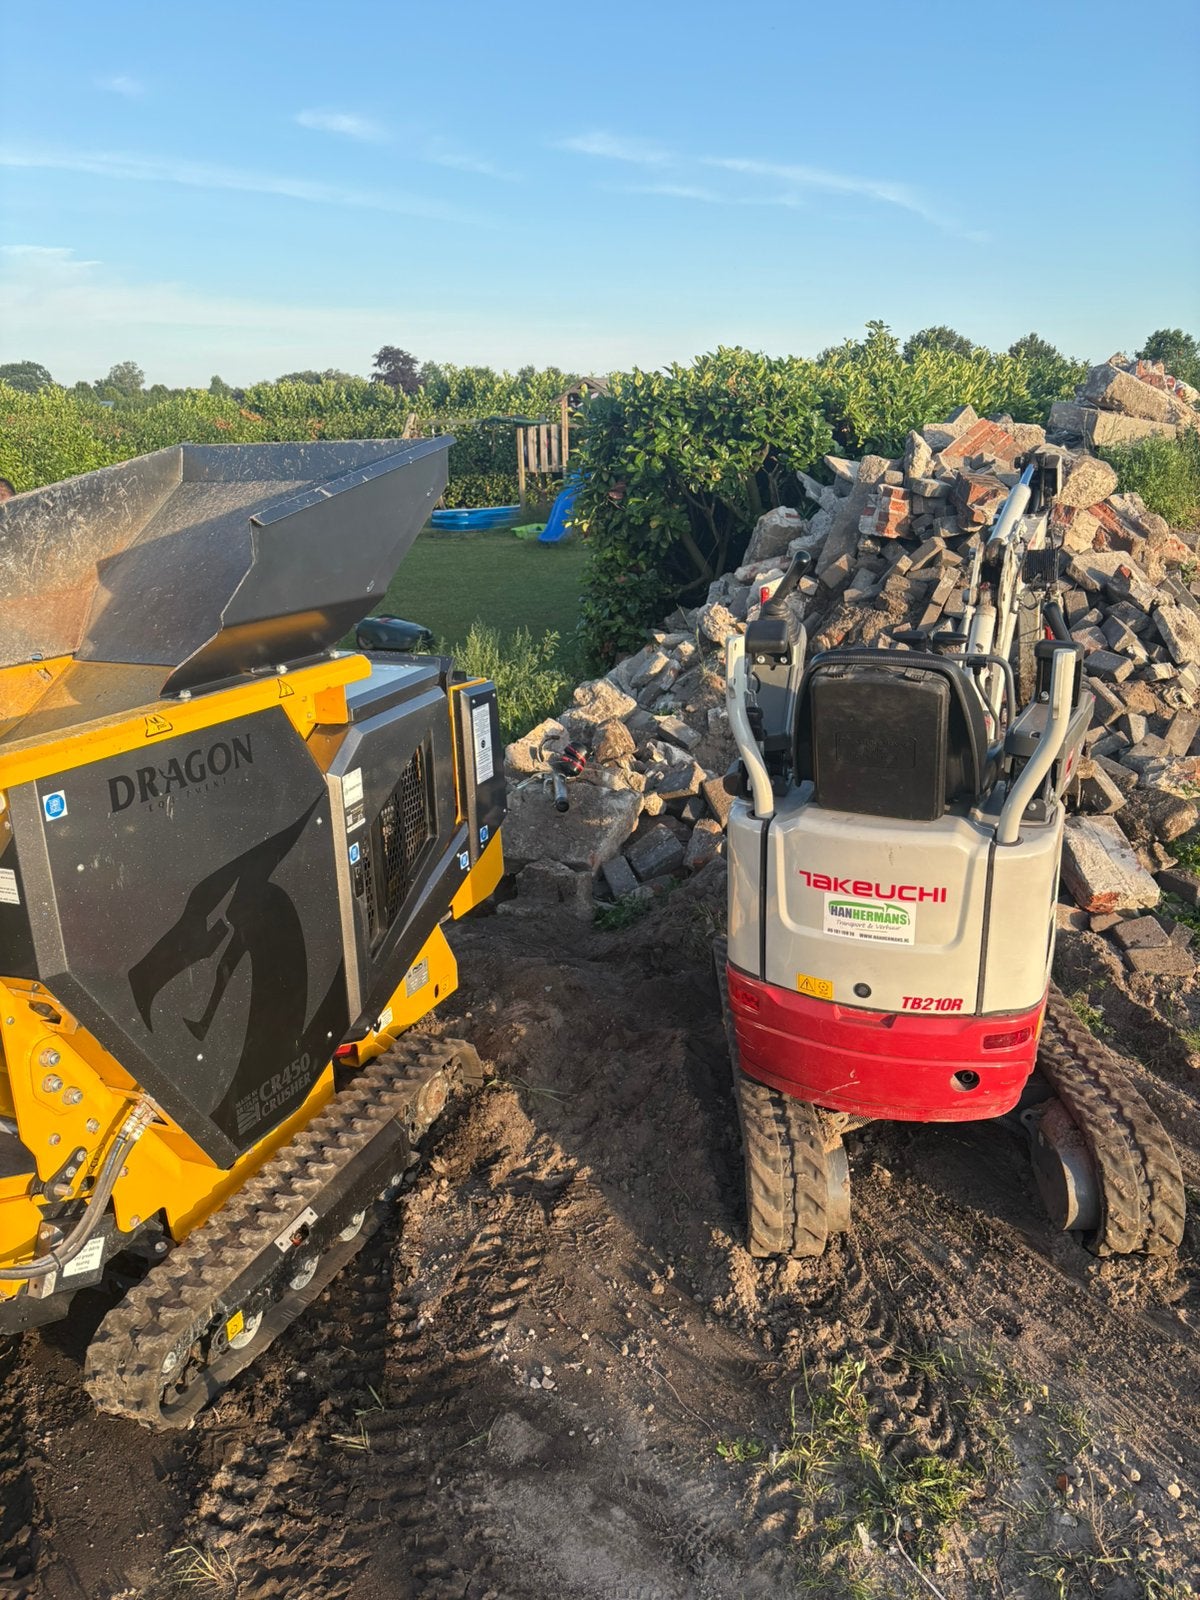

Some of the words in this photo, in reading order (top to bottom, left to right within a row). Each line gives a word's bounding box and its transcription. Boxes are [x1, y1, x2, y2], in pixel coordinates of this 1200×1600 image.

[106, 733, 254, 813] DRAGON
[902, 996, 964, 1012] TB210R
[259, 1052, 311, 1101] CR450
[261, 1071, 312, 1117] CRUSHER
